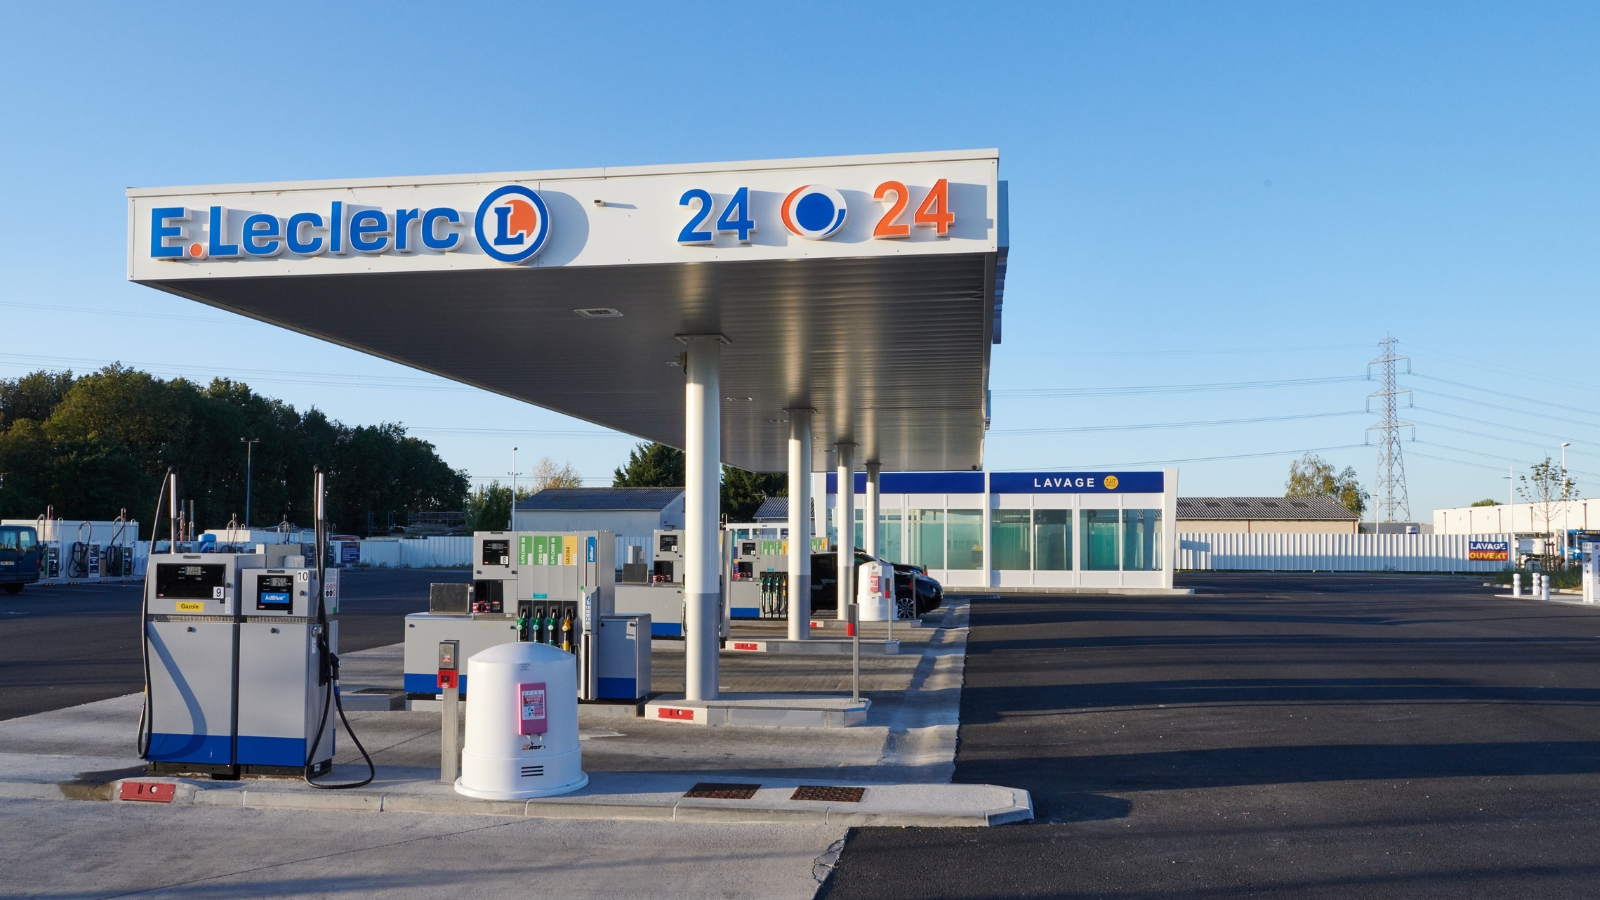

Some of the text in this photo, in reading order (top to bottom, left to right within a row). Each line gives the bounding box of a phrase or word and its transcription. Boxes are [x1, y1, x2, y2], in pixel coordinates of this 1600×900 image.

[678, 178, 955, 244] 24 24
[151, 201, 461, 259] E.Leclerc
[1034, 478, 1095, 487] LAVAGE
[502, 556, 507, 564] 8
[297, 571, 308, 581] 10
[216, 587, 222, 597] 9
